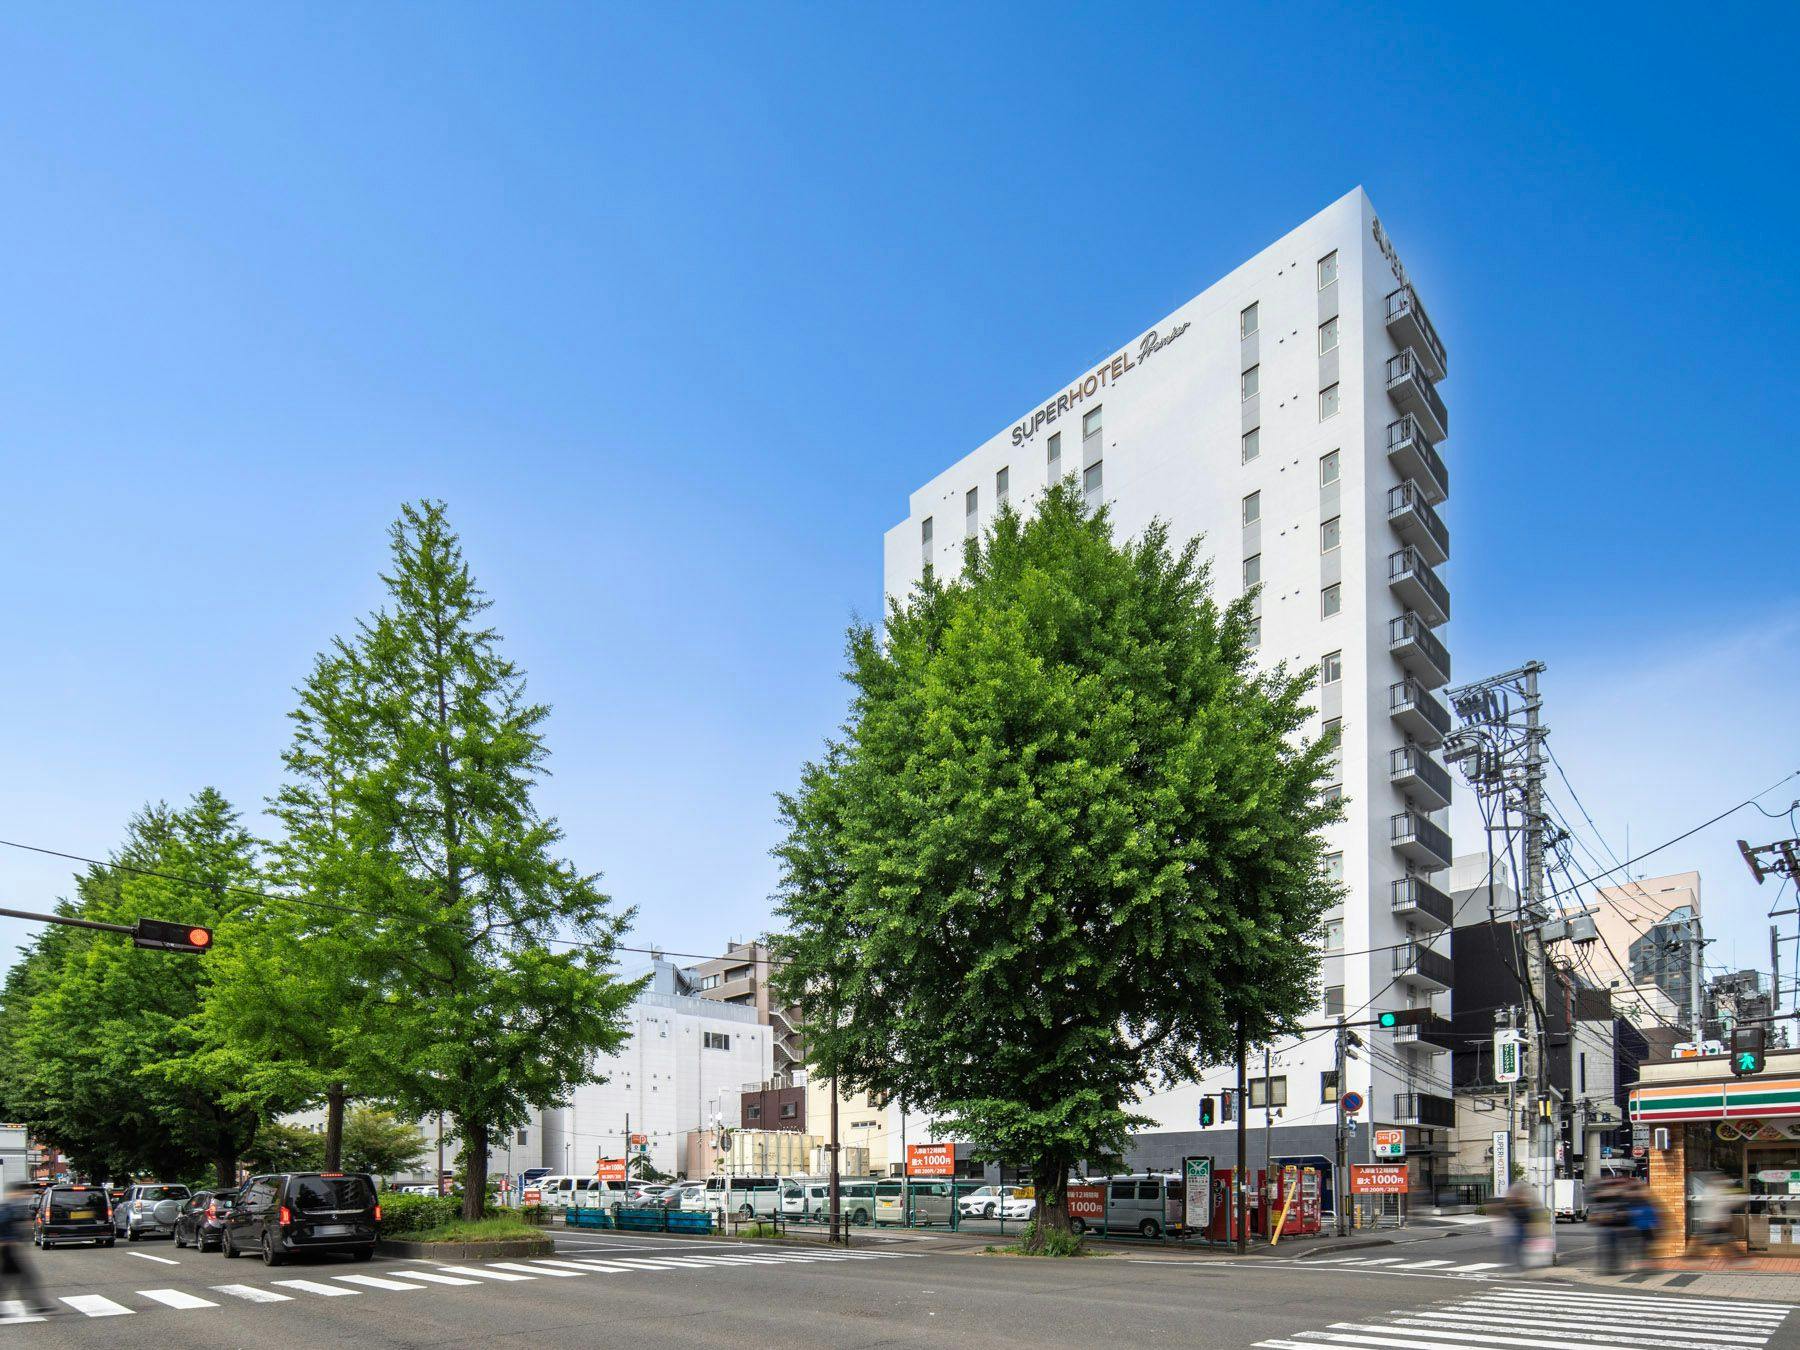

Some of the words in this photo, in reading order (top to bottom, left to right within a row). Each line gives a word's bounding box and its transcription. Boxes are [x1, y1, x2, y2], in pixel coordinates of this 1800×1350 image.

[1012, 352, 1135, 446] SUPERHOTEL
[1496, 1134, 1505, 1178] SUPERHOTEL
[1068, 1201, 1103, 1212] 1000円
